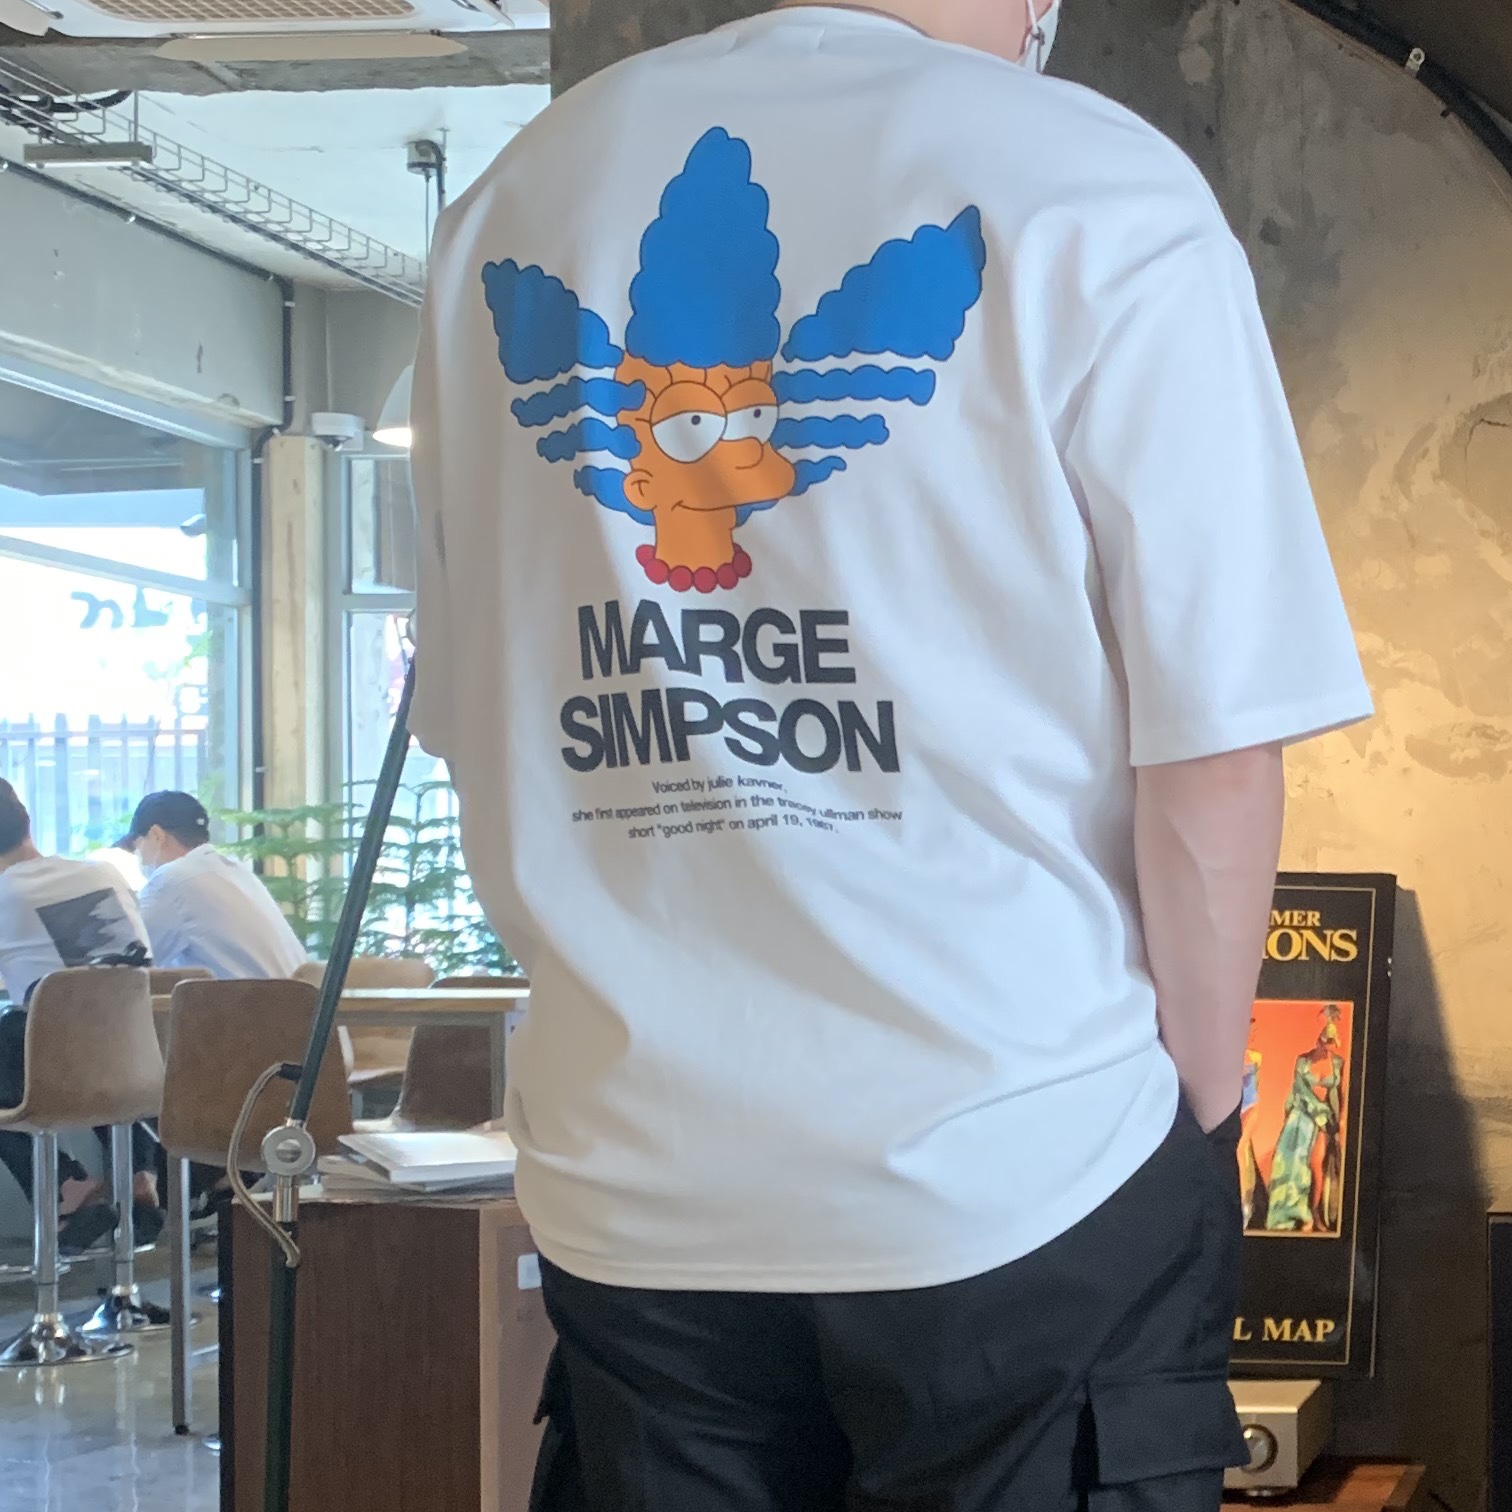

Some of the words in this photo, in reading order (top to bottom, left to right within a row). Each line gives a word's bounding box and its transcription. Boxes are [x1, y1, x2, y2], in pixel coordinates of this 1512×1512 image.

[577, 599, 857, 685] MARGE
[560, 687, 901, 774] SIMPSON
[652, 778, 690, 794] Voiced
[691, 778, 705, 792] by
[707, 775, 733, 792] julie
[572, 810, 594, 822] she
[594, 807, 613, 820] first
[615, 804, 661, 820] appeared
[663, 803, 678, 815] on
[680, 798, 732, 813] television
[735, 796, 747, 808] in
[750, 795, 775, 808] the
[867, 807, 902, 820] show
[628, 825, 655, 839] short
[729, 819, 745, 830] on
[747, 813, 778, 831] april
[1270, 909, 1321, 927] MER
[1233, 1317, 1252, 1341] L
[1262, 1317, 1335, 1342] MAP
